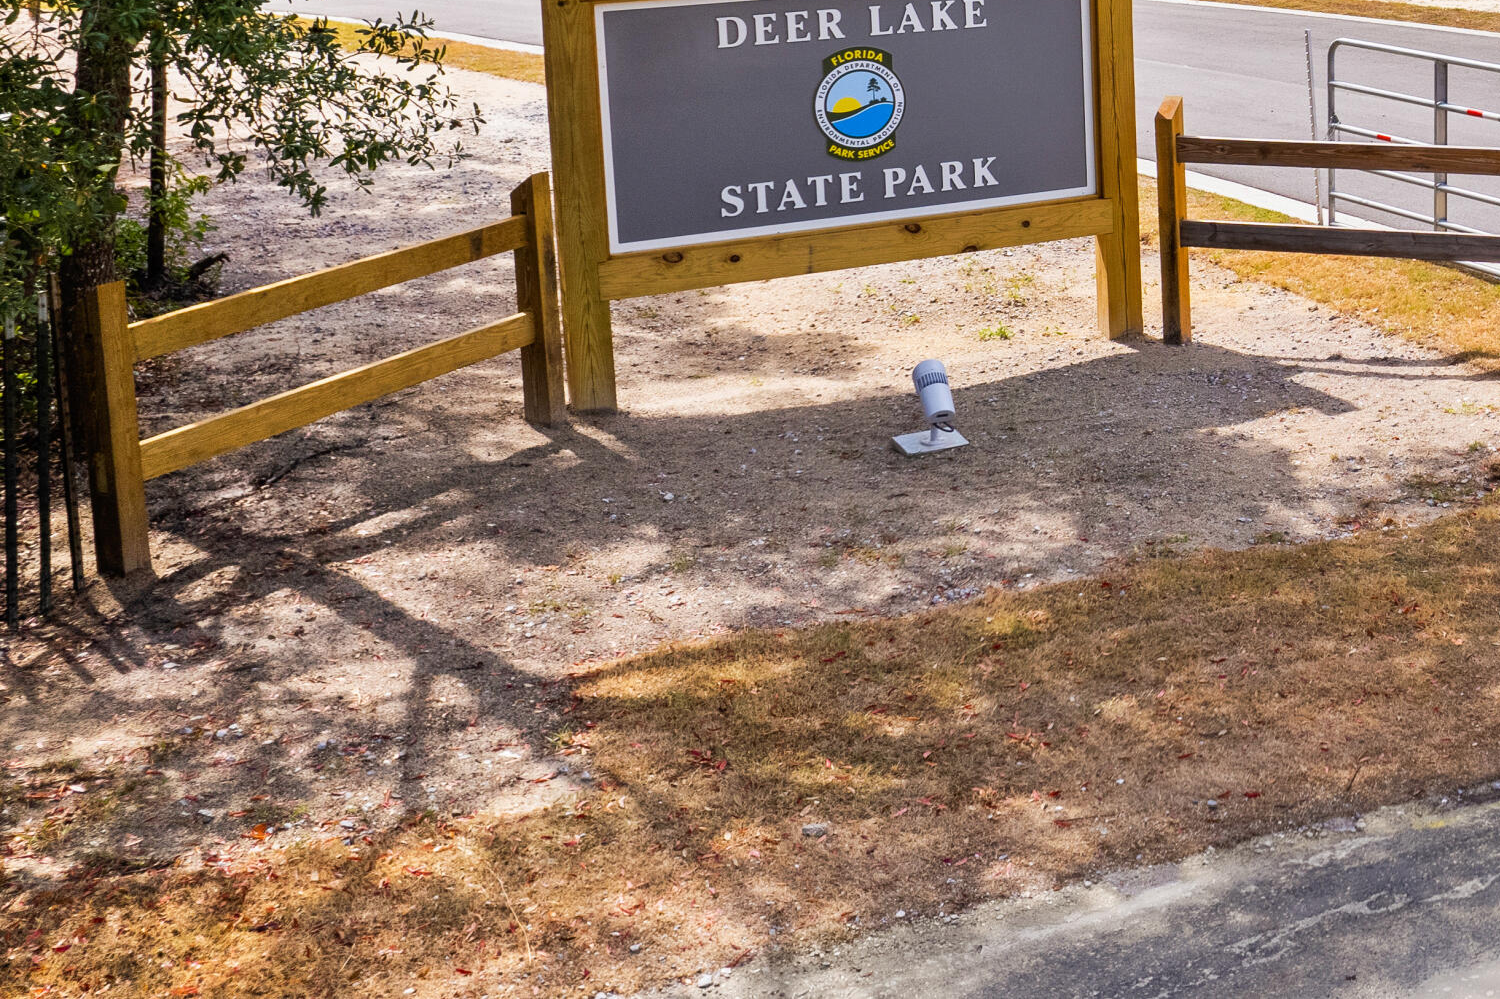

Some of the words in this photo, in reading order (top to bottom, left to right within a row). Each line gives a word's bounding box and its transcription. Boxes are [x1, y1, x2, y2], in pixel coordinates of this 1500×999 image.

[715, 9, 847, 50] DEER
[830, 49, 884, 67] FLORIDA
[818, 69, 842, 99] FLORIDA
[844, 62, 894, 82] DEPARTMENT
[892, 82, 902, 93] OF
[816, 108, 870, 146] ENVIRONMENTAL
[872, 101, 904, 142] PROTECTION
[829, 144, 856, 159] PARK
[857, 139, 895, 159] SERVICE
[719, 171, 866, 219] STATE
[882, 156, 1000, 199] PARK
